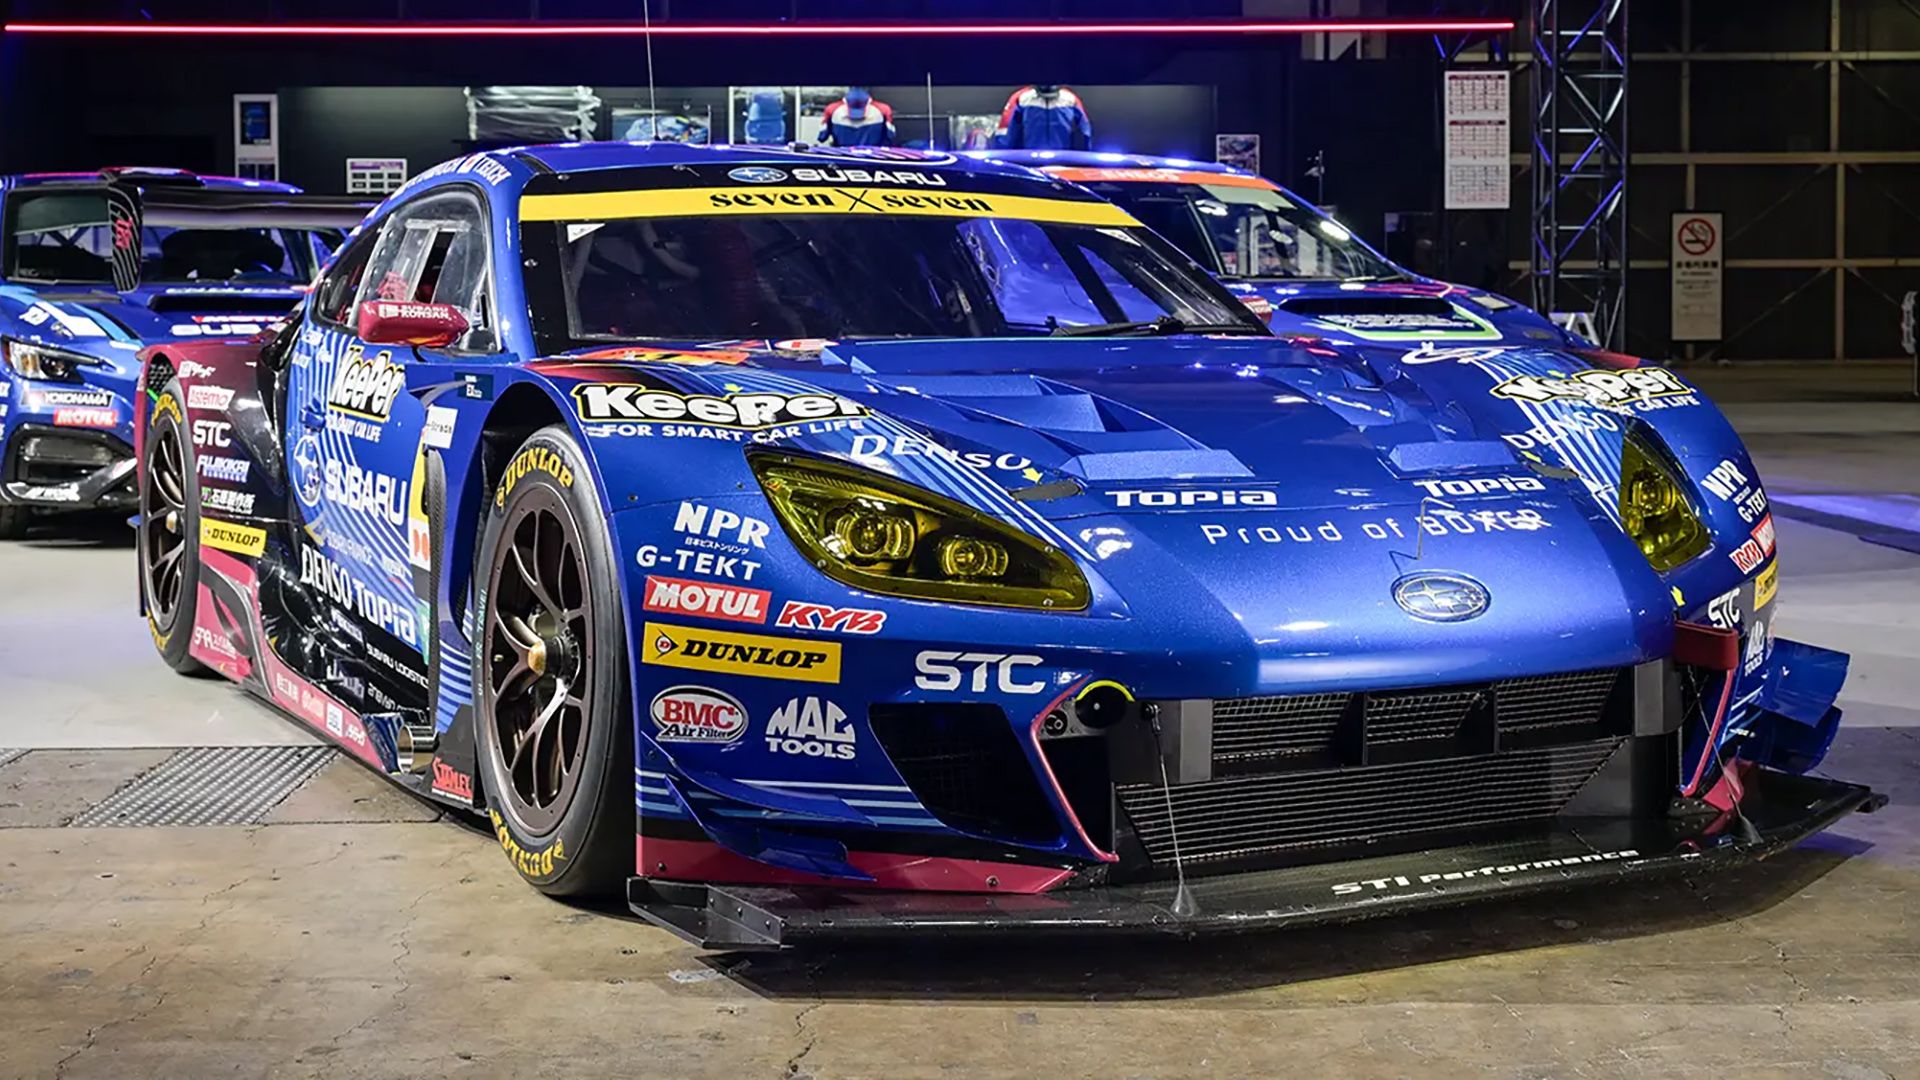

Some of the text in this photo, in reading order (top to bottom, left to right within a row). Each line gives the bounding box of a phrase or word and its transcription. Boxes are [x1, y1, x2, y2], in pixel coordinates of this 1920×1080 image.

[791, 168, 946, 187] SUBARU
[709, 190, 835, 207] seven
[882, 193, 994, 212] seven
[44, 391, 109, 406] YOKOHAMA
[580, 385, 868, 427] KeePer
[1667, 394, 1700, 408] LIFE
[57, 408, 114, 426] MOTUL
[603, 420, 864, 443] FOR SMART CAR LIFE
[1501, 412, 1618, 449] DENSO
[192, 419, 232, 448] STC
[850, 434, 1032, 471] DENSO
[506, 447, 574, 496] DUNLOP
[1701, 460, 1748, 500] NPR
[325, 458, 408, 526] SUBARU
[211, 528, 260, 547] DUNLOP
[673, 501, 771, 549] NPR
[1201, 523, 1344, 546] Proud
[1366, 517, 1405, 540] of
[684, 536, 750, 555] 日本ピストンリング
[300, 542, 352, 611] DENSO
[636, 545, 761, 580] G-TEKT
[648, 582, 763, 618] MOTUL
[1708, 588, 1741, 629] STC
[776, 602, 887, 633] KYB
[681, 640, 828, 668] DUNLOP
[914, 651, 1046, 694] STC
[661, 699, 735, 729] BMC
[765, 696, 856, 743] MAC
[661, 723, 729, 738] Air Filter
[765, 737, 856, 760] TOOLS
[1331, 850, 1640, 896] STI Performance
